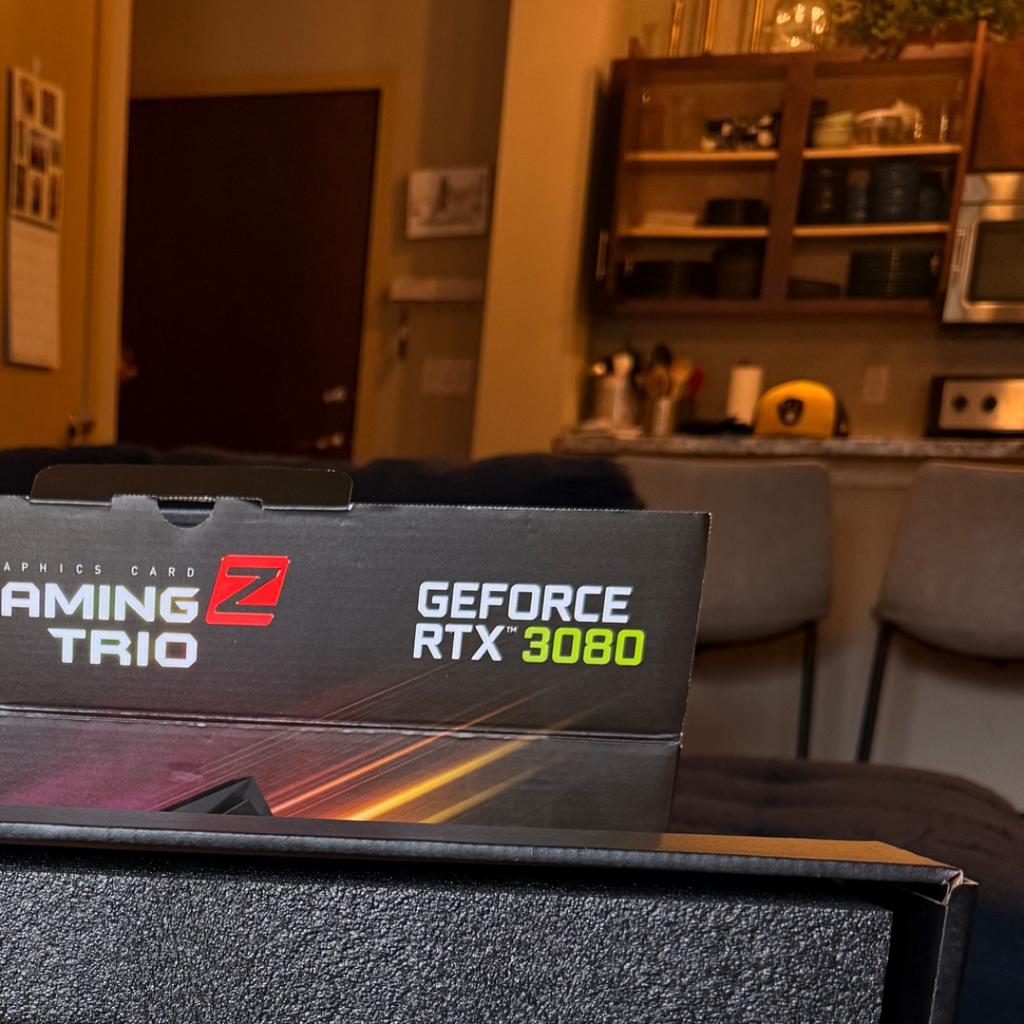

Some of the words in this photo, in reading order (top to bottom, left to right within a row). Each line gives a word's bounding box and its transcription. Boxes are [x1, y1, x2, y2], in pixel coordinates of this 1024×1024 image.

[130, 566, 196, 578] CARD
[417, 581, 633, 623] GEFORCE
[47, 628, 198, 668] TRIO
[521, 626, 645, 666] 3080
